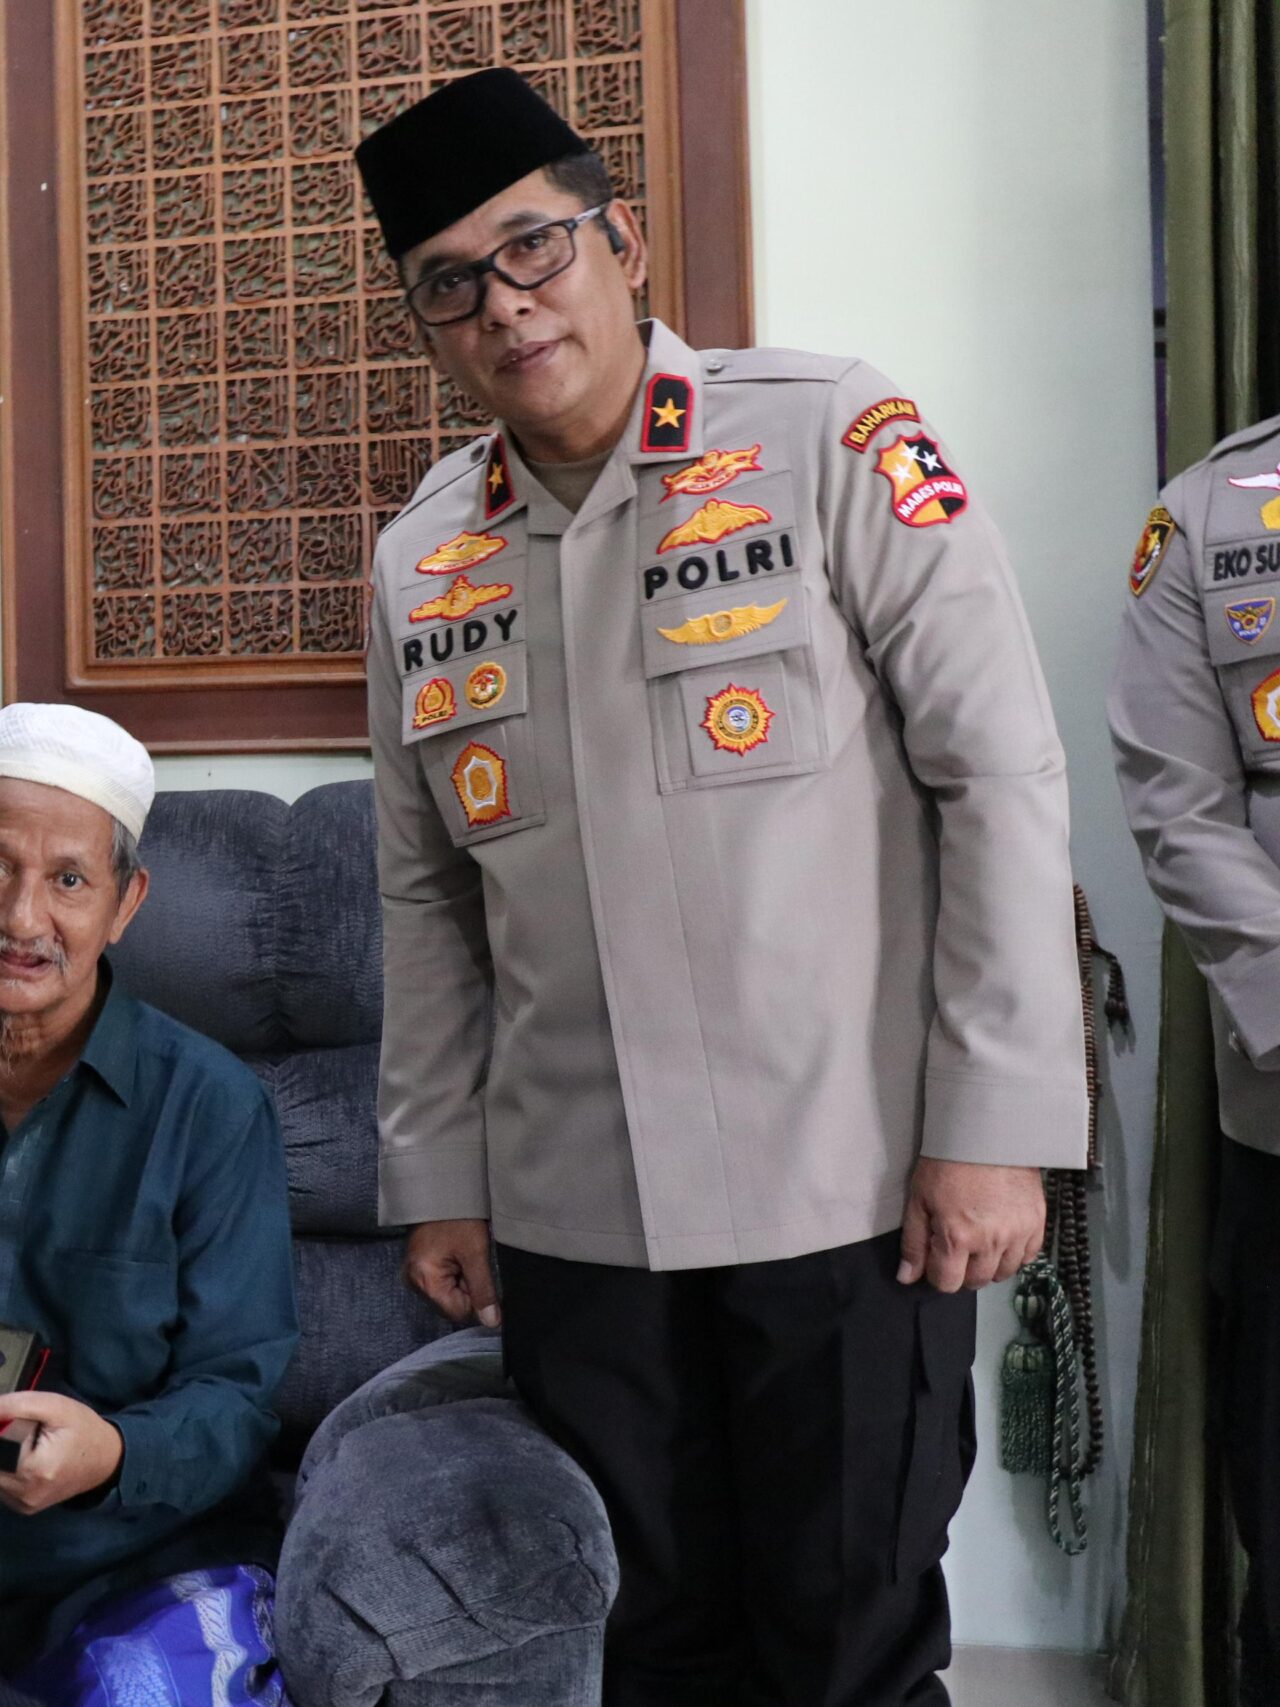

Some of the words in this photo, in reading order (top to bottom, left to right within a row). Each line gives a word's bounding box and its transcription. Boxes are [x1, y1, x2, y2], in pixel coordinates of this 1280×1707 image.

[847, 400, 917, 445] BAHARKAM
[897, 484, 936, 519] MABES
[643, 533, 794, 600] POLRI
[1213, 547, 1251, 581] EKO
[1254, 541, 1280, 575] SU
[403, 608, 519, 672] RUDY
